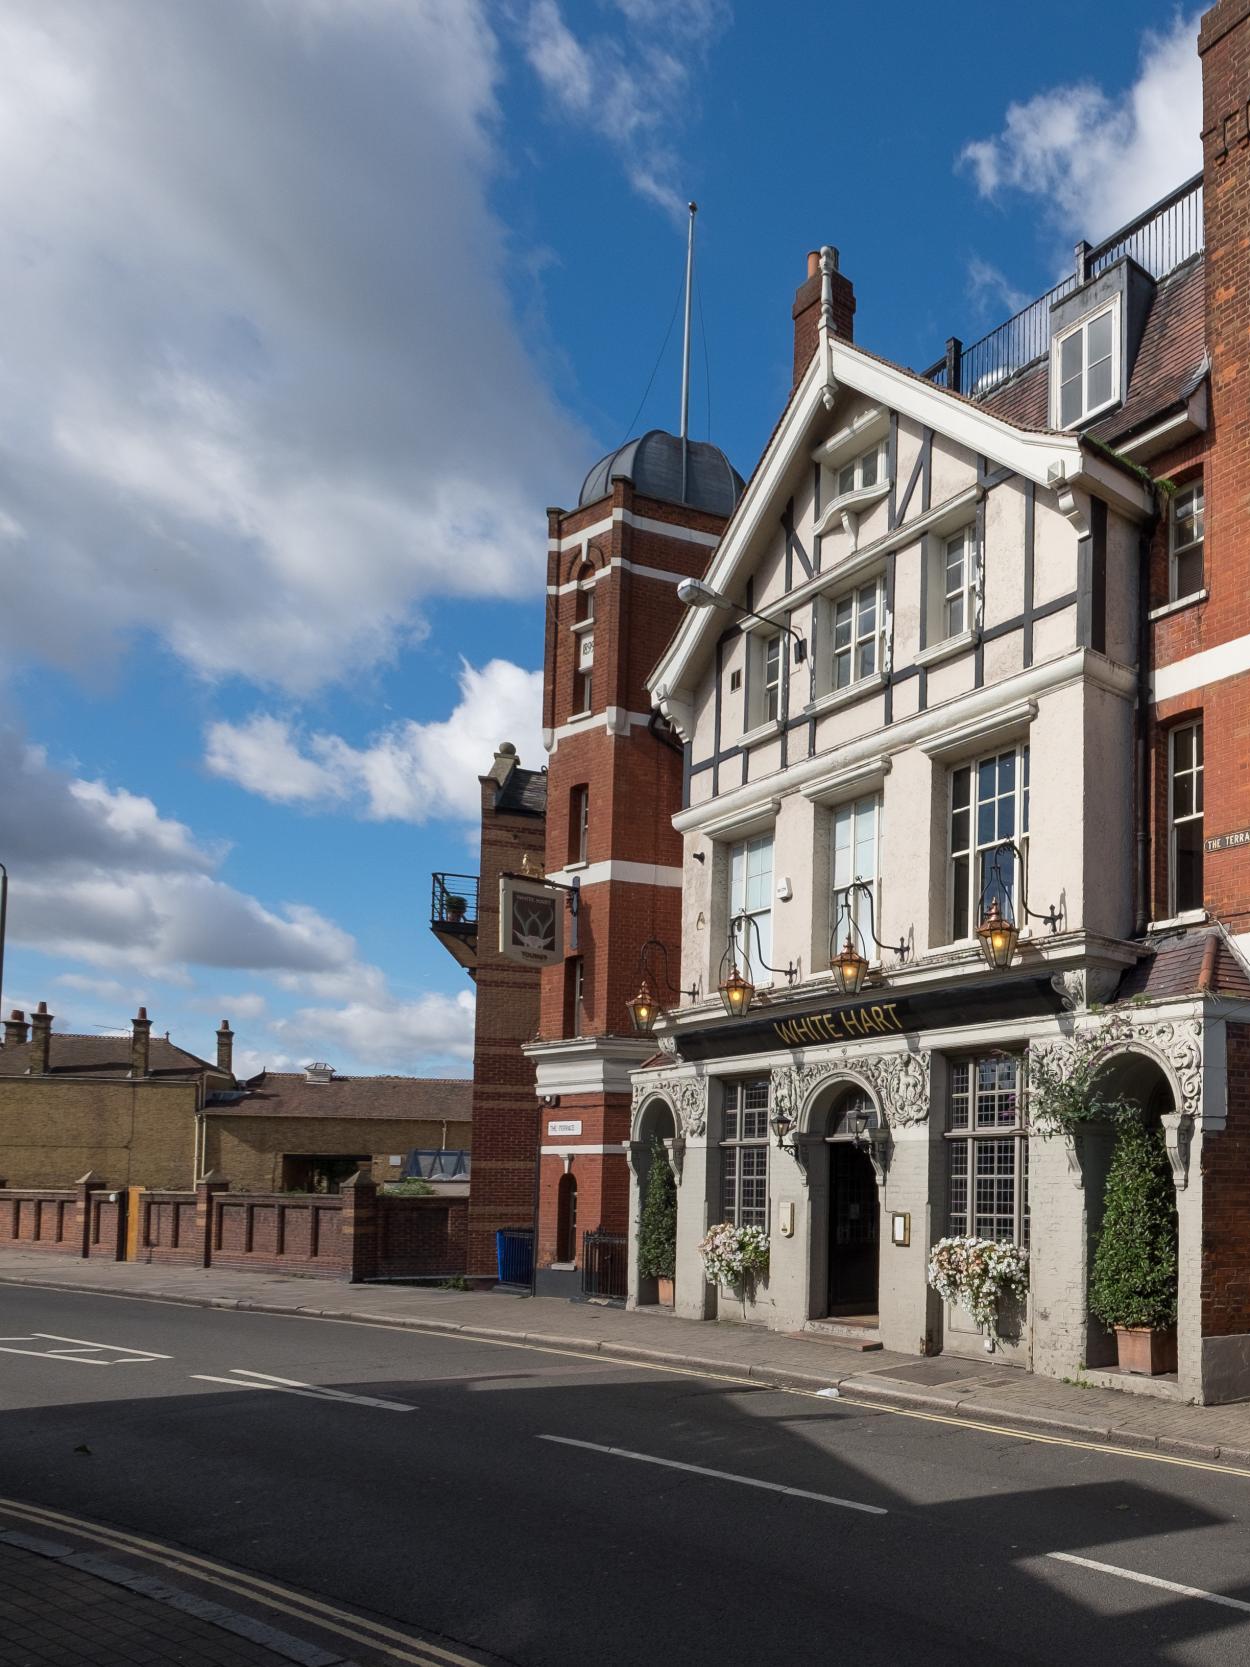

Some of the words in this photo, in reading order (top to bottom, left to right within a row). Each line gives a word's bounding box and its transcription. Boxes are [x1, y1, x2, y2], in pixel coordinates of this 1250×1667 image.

[1208, 838, 1222, 850] THE
[774, 1013, 844, 1044] WHITE
[840, 1003, 903, 1035] HART
